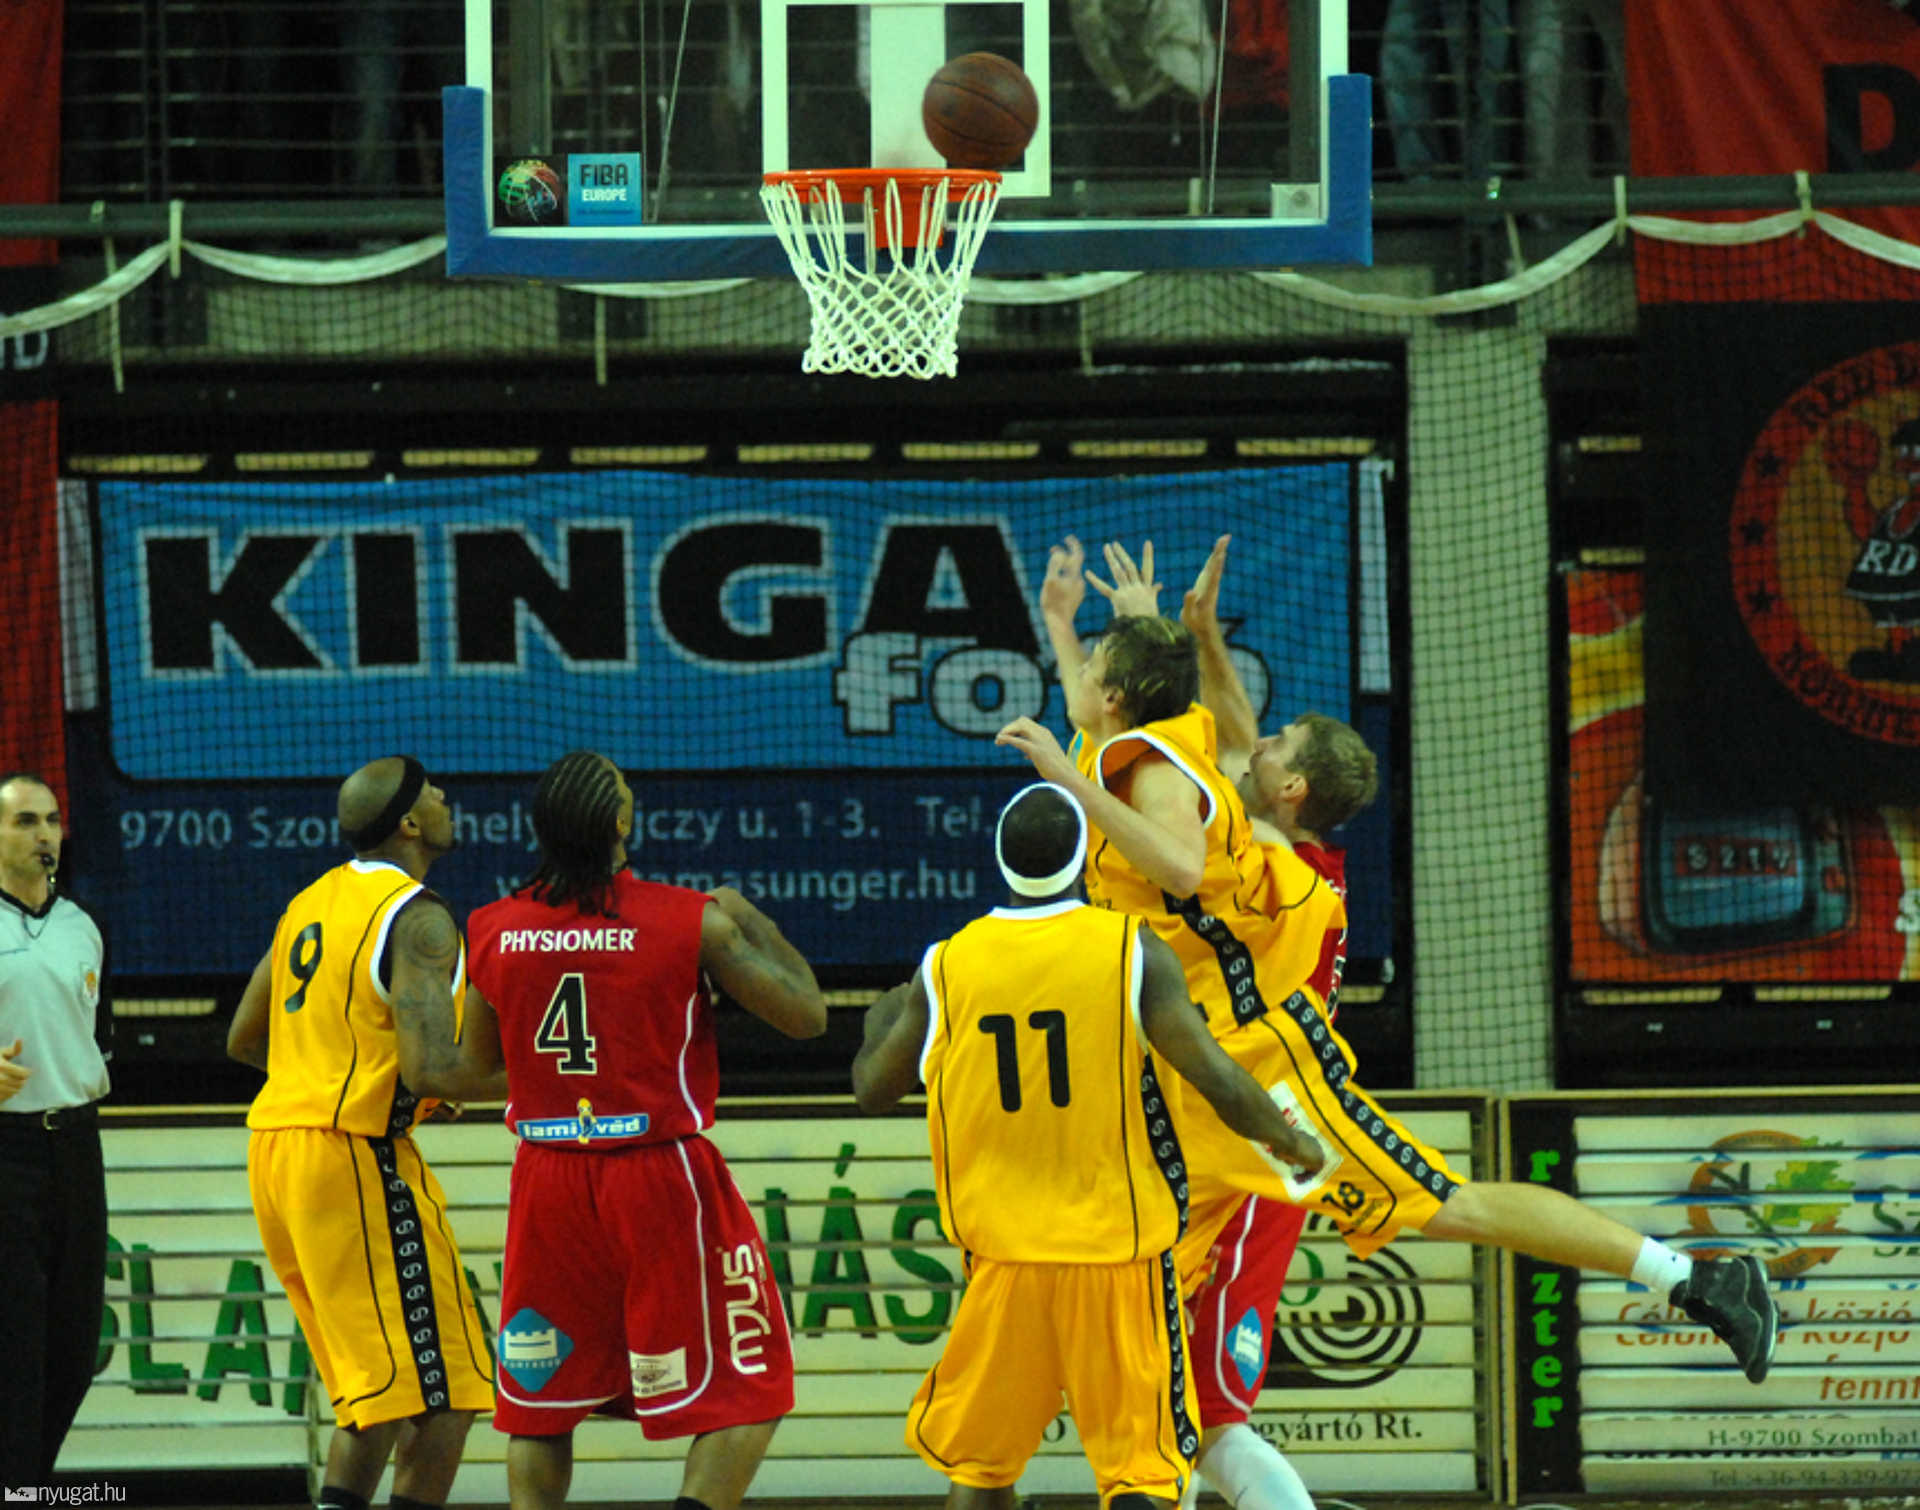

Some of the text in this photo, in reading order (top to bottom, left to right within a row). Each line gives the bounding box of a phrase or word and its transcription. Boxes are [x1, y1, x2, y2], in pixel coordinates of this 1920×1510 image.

[580, 163, 628, 187] FIBA
[581, 187, 627, 202] EUROPE
[138, 511, 1058, 678] KINGA
[119, 807, 232, 849] 9700
[738, 805, 778, 838] u.
[800, 800, 880, 839] 1-3.
[916, 796, 992, 838] Tel.
[500, 928, 636, 954] PHYSIOMER
[285, 921, 323, 1014] 9
[534, 972, 598, 1075] 4
[977, 1008, 1071, 1113] 11
[1321, 1181, 1365, 1217] 18
[1528, 1149, 1563, 1429] rzter
[1375, 1409, 1423, 1440] Rt.
[1708, 1429, 1801, 1447] H-9700
